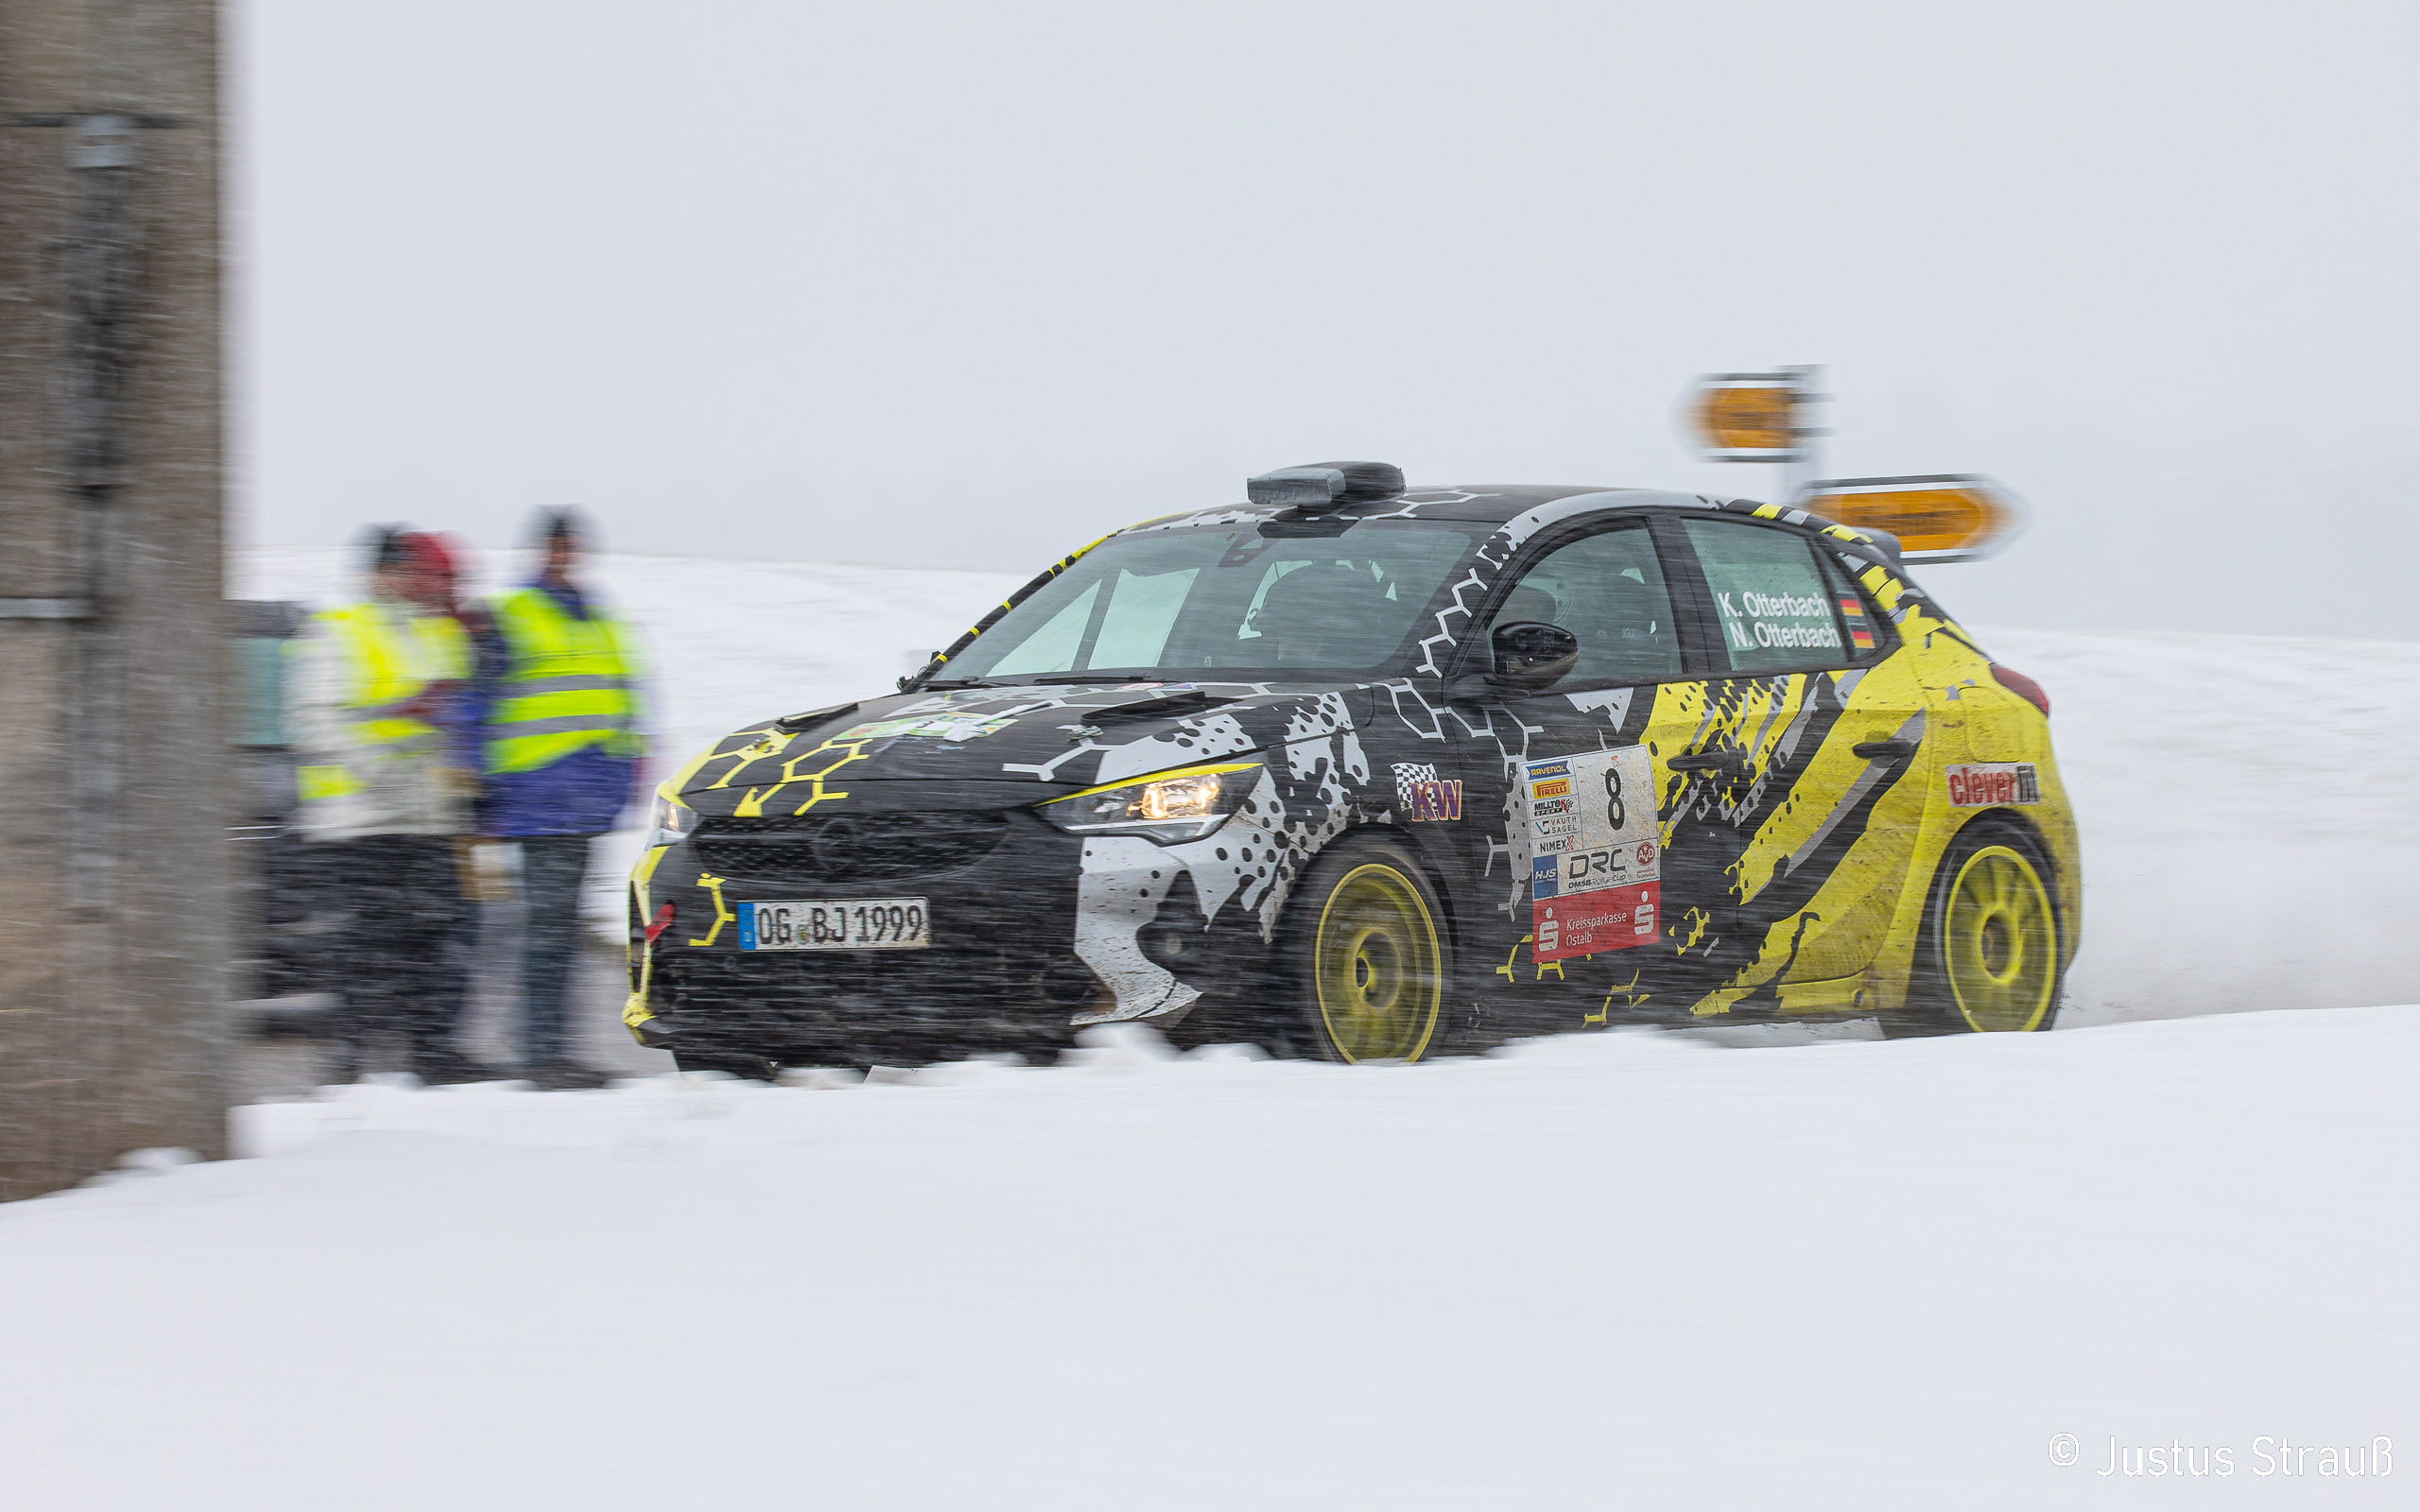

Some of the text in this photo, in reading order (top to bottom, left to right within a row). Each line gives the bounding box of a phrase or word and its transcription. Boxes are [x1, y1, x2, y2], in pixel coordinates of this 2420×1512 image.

[1718, 591, 1832, 617] K. Otterbach
[1729, 621, 1842, 647] N. Otterbach
[1409, 780, 1462, 821] KW
[1536, 782, 1566, 797] PIRELLI
[1604, 767, 1625, 831] 8
[1551, 816, 1577, 825] VAUTH
[1552, 825, 1577, 833] SAGEL
[1534, 868, 1557, 881] HJS
[1569, 848, 1626, 879] DRC
[759, 905, 923, 944] OG BJ 1999
[1566, 910, 1627, 931] Kreissparkasse
[1565, 933, 1593, 946] Ostalb
